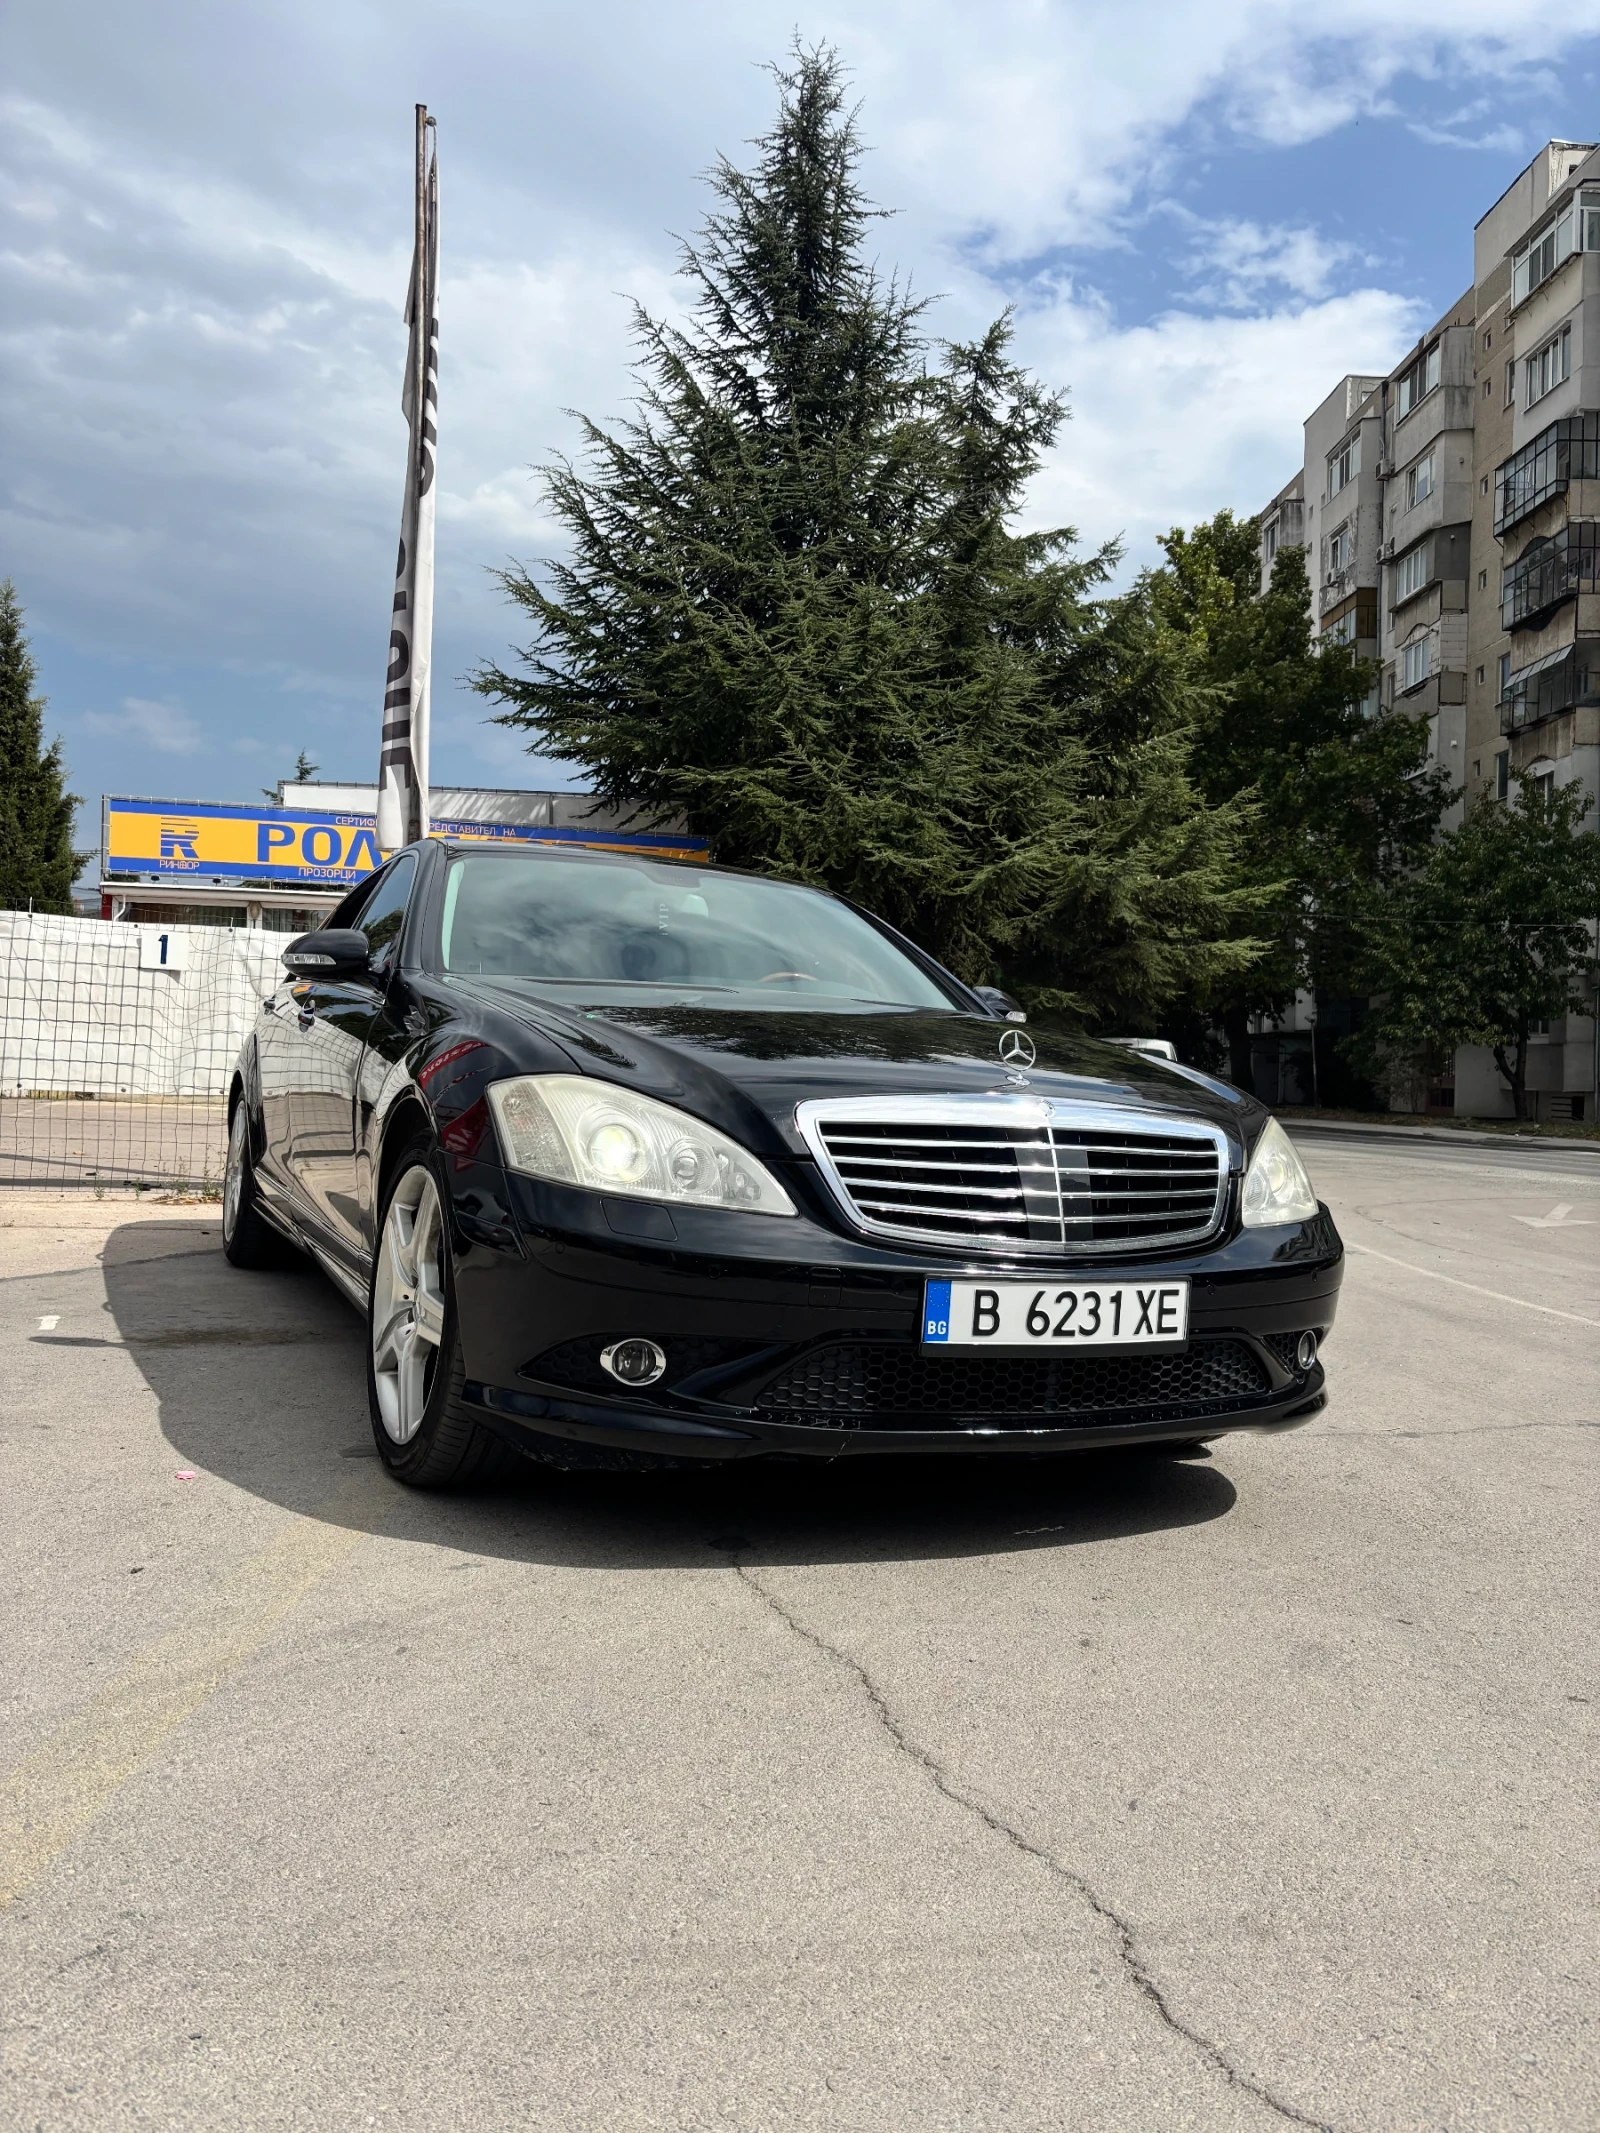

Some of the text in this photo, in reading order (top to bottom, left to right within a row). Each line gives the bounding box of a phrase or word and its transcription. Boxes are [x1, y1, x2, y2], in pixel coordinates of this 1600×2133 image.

[503, 828, 516, 836] НА
[298, 867, 356, 880] ПРОЗОРЦИ
[158, 934, 169, 965] 1
[972, 1289, 1180, 1337] B 6231 XE
[927, 1320, 947, 1335] BG
